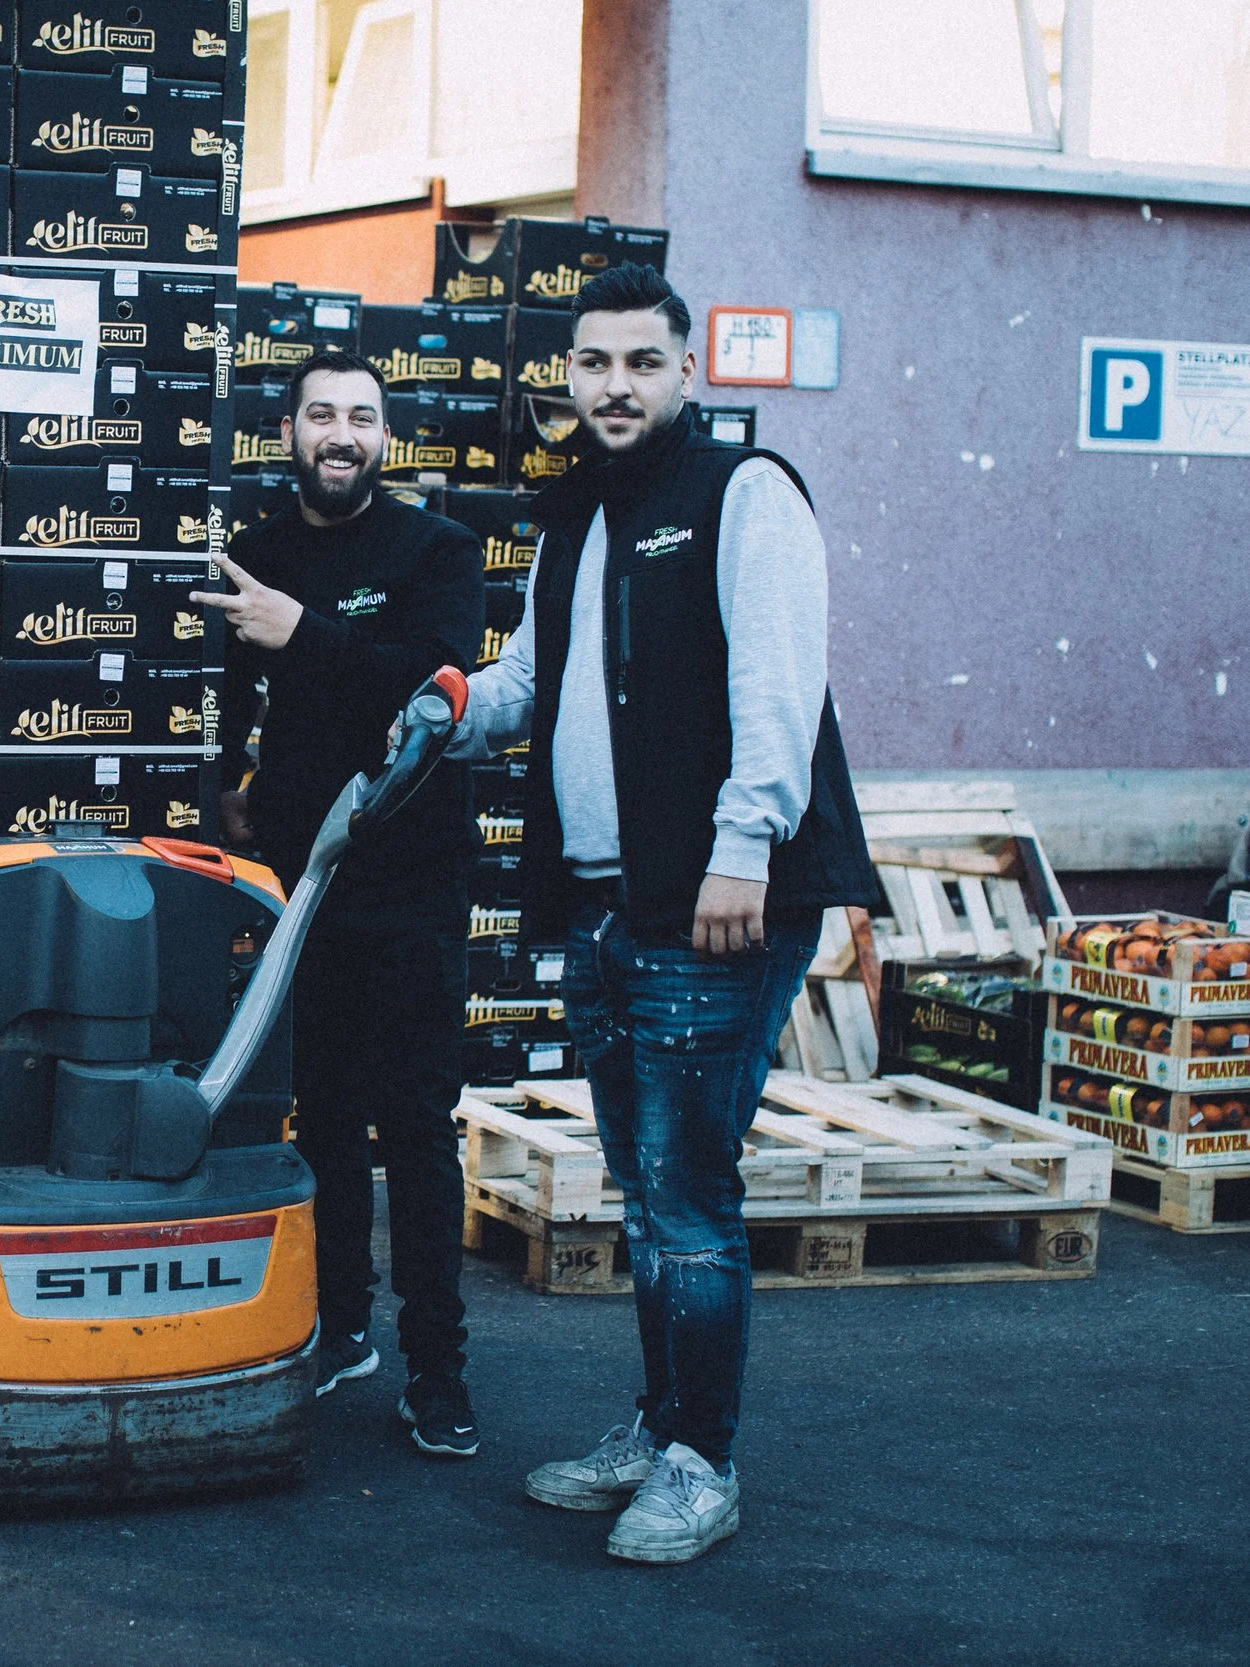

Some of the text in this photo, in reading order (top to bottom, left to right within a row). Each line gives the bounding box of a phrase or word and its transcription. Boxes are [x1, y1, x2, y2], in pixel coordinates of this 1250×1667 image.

[229, 3, 240, 29] FRUIT
[110, 34, 151, 46] FRUIT
[197, 41, 225, 51] FRESH
[108, 132, 149, 145] FRUIT
[222, 188, 232, 213] FRUIT
[103, 231, 144, 244] FRUIT
[101, 329, 142, 342] FRUIT
[423, 362, 456, 374] FRUIT
[218, 369, 226, 395] FRUIT
[1104, 358, 1149, 431] P
[97, 426, 138, 439] FRUIT
[388, 437, 452, 468] lif FRUIT
[95, 523, 136, 537] FRUIT
[654, 526, 678, 536] FRESH
[635, 528, 692, 552] MAXIMUM
[337, 592, 386, 610] MAXIMUM
[92, 619, 133, 632] FRUIT
[87, 715, 129, 728] FRUIT
[173, 716, 201, 727] FRESH
[171, 812, 198, 823] FRESH
[1071, 965, 1150, 1004] PRIMAVERA
[1068, 1038, 1149, 1080] PRIMAVERA
[36, 1257, 242, 1300] STILL
